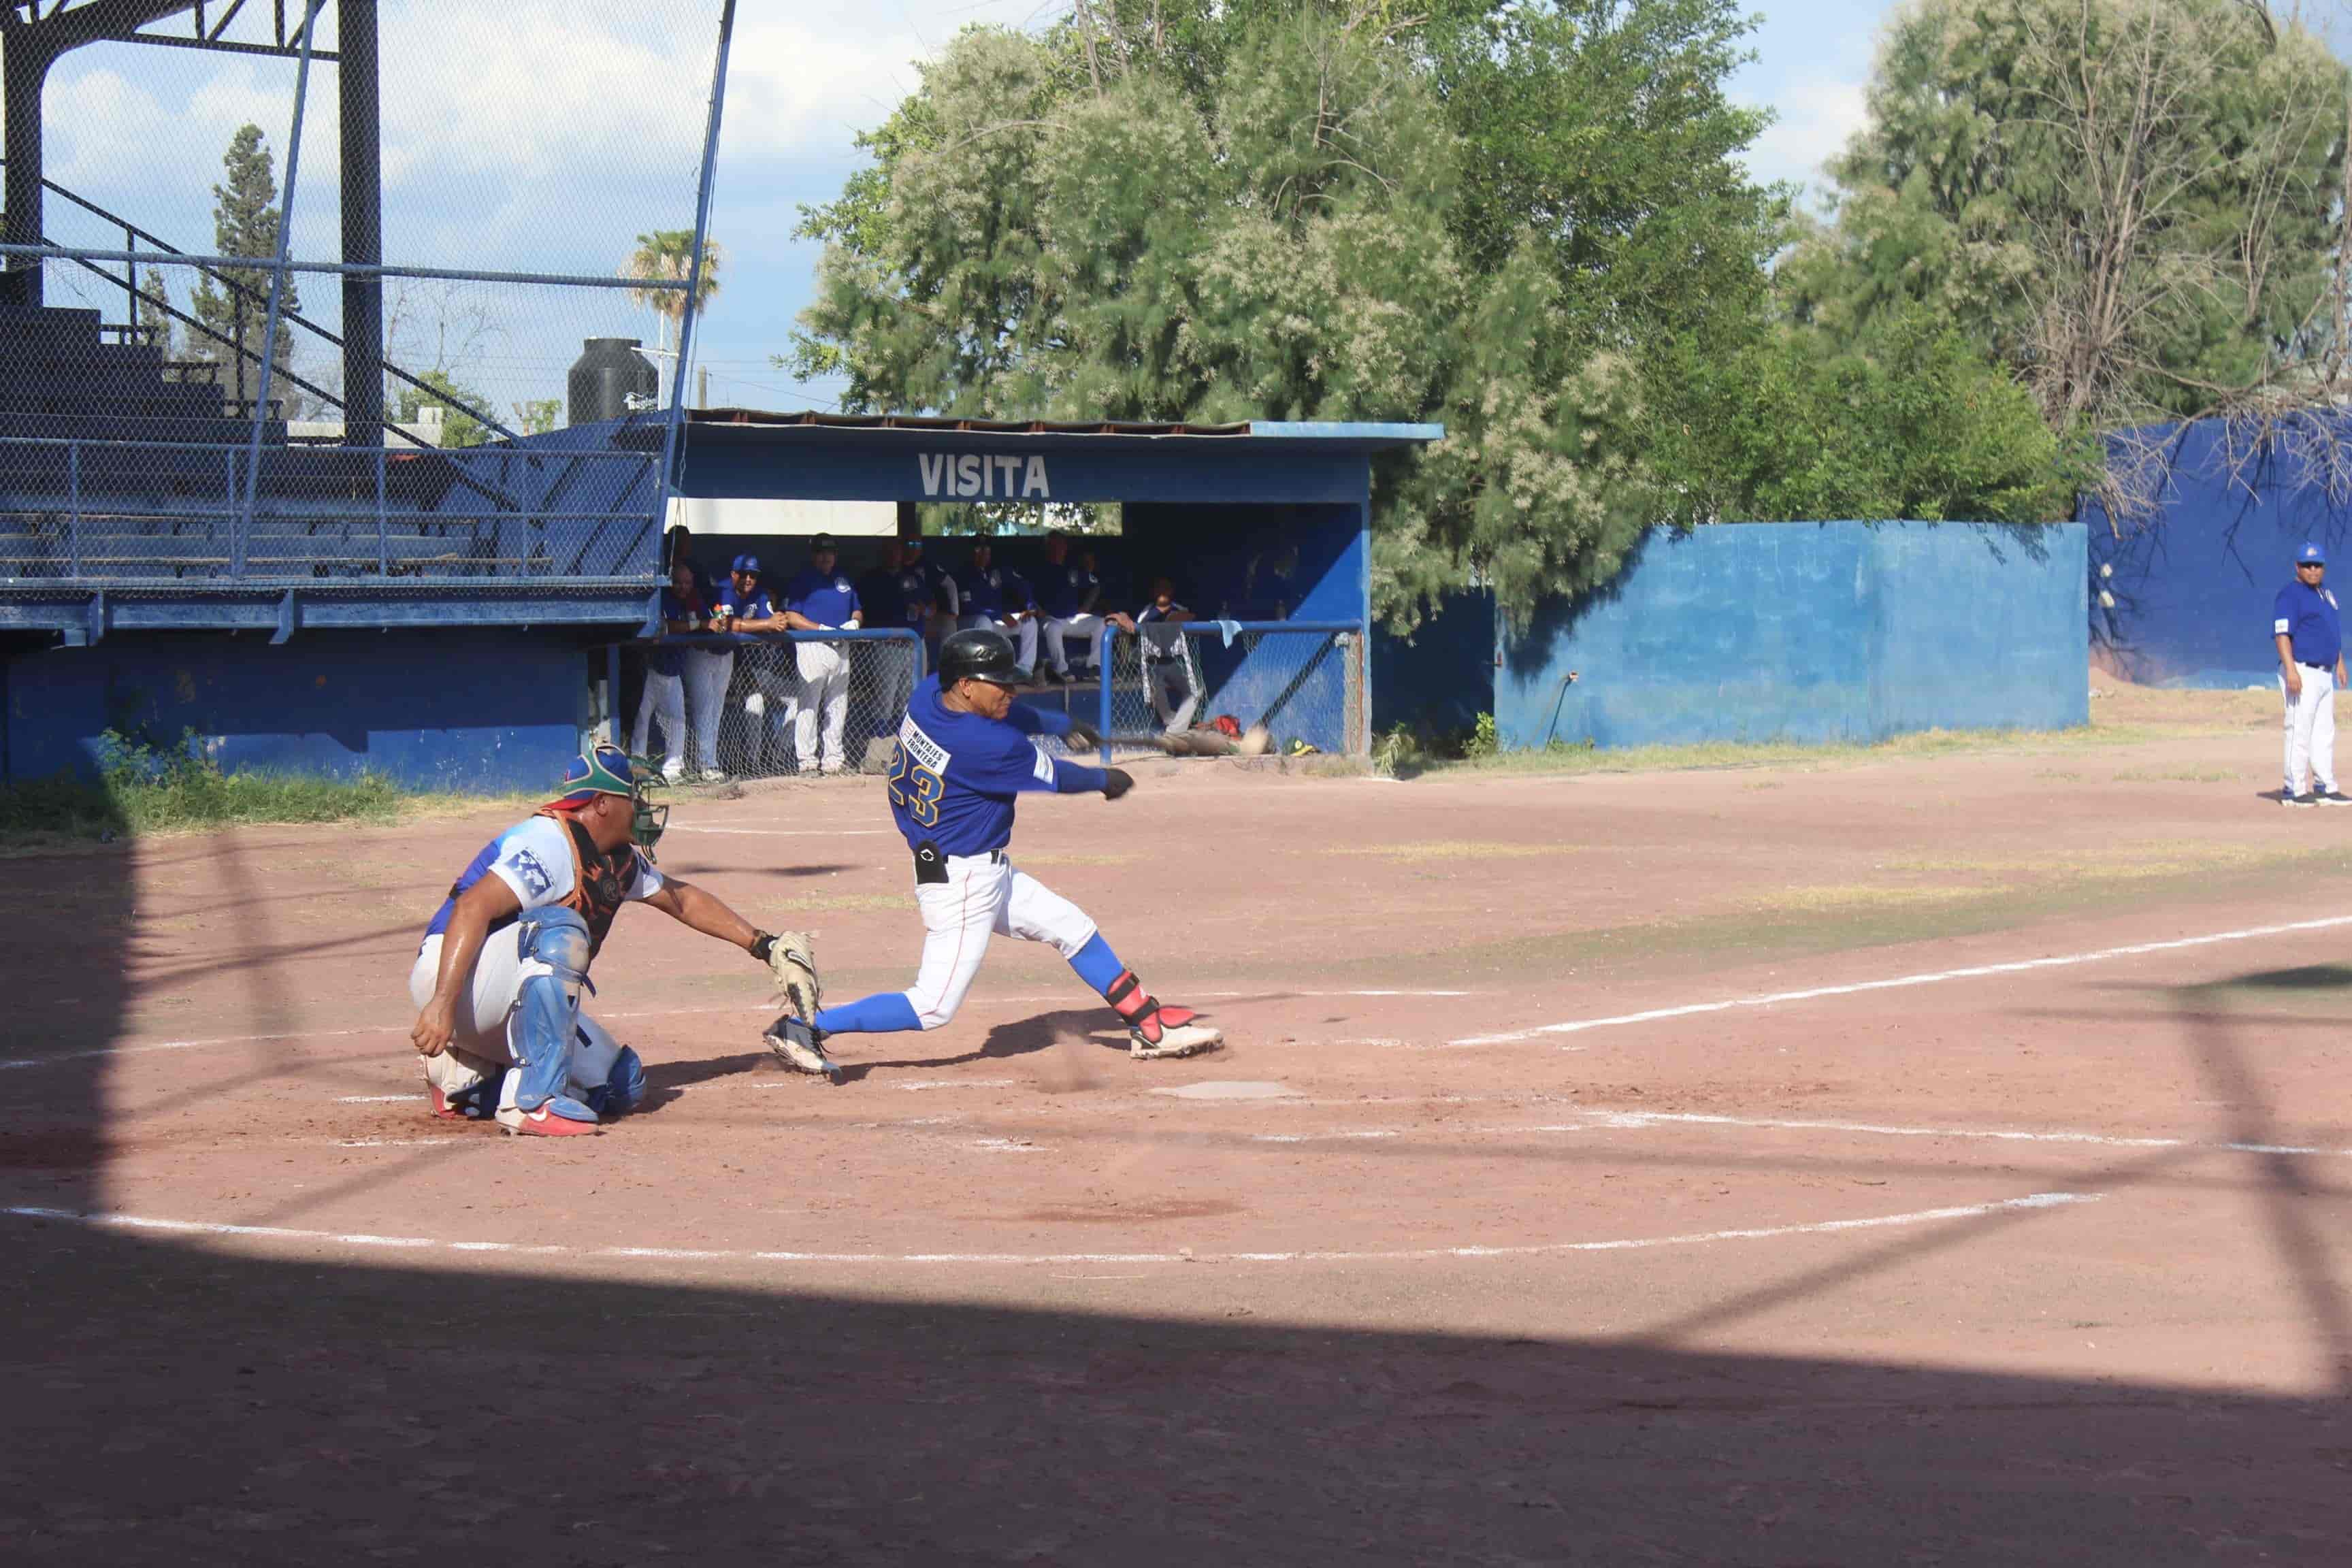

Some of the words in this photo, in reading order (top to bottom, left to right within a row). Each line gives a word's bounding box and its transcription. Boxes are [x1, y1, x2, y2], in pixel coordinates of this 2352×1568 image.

[919, 454, 1049, 497] VISITA
[906, 738, 938, 768] FRONTERA
[888, 740, 945, 828] 23
